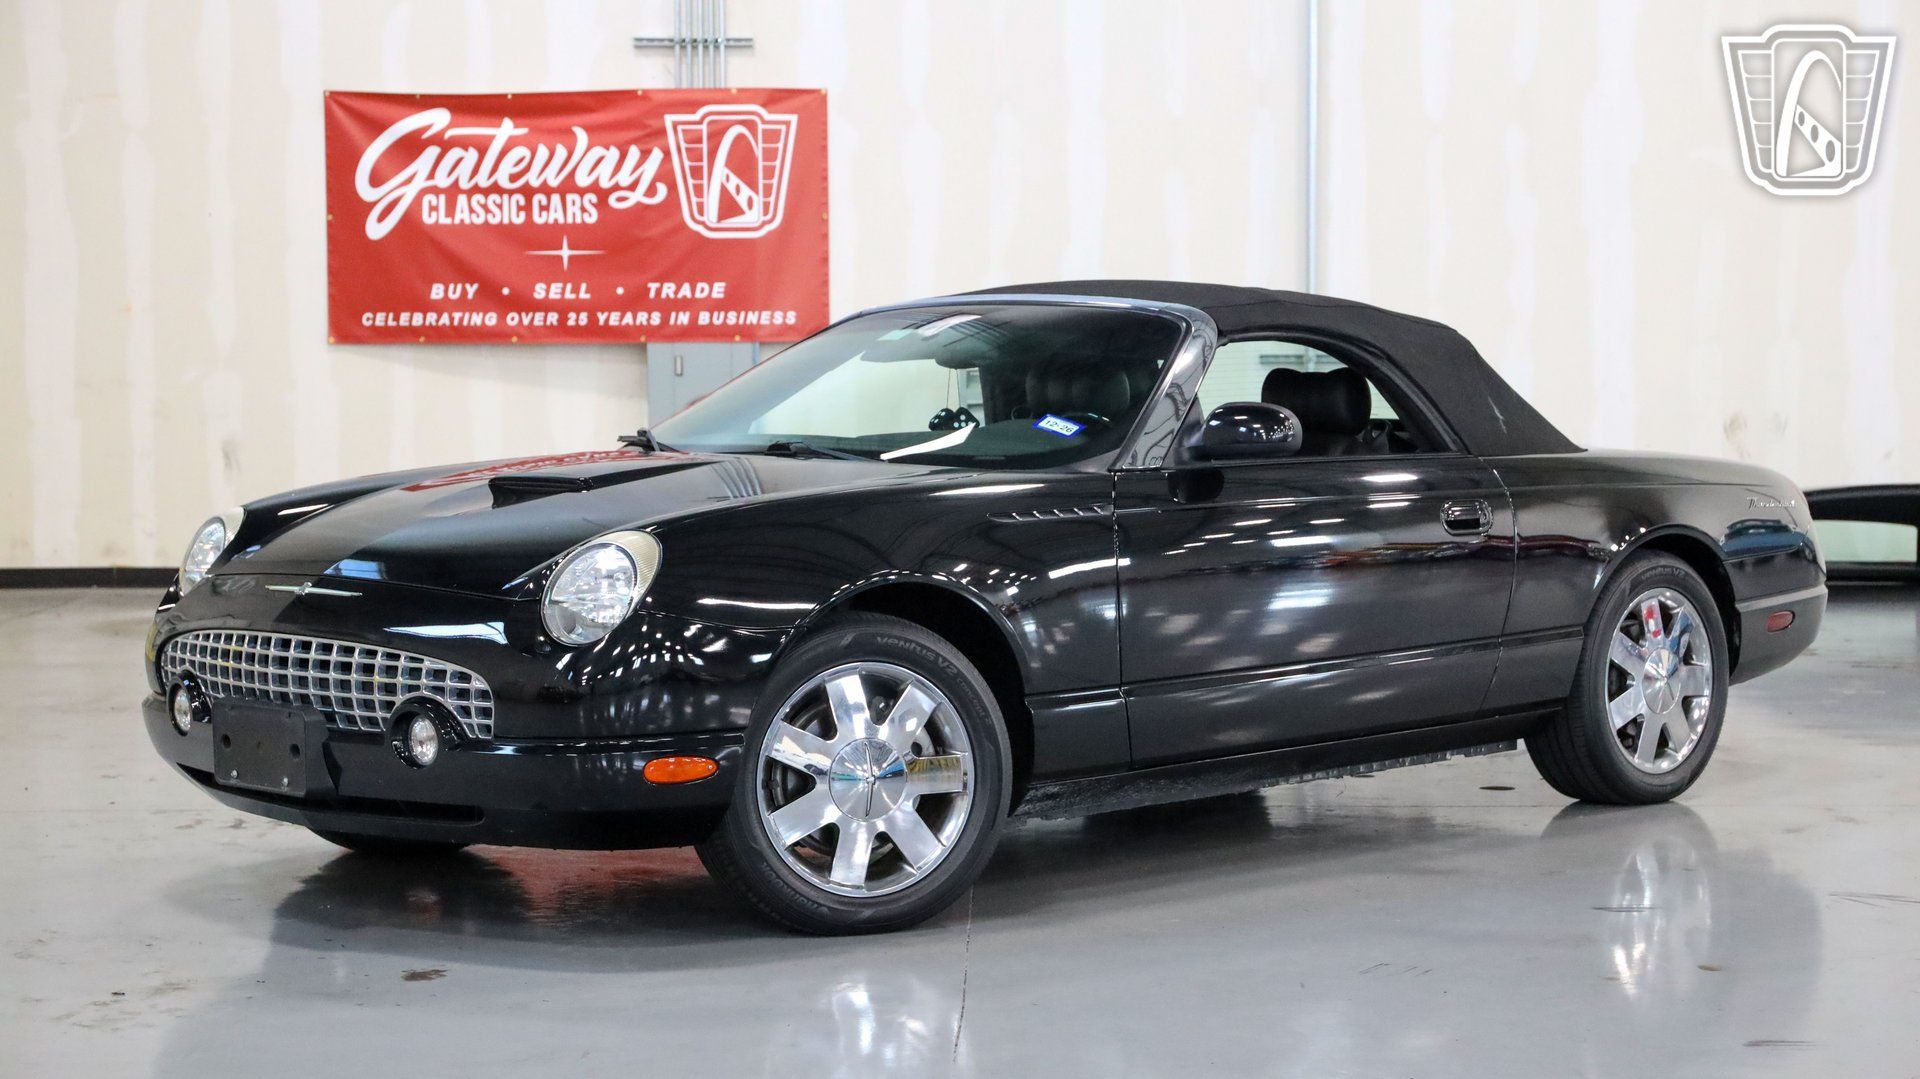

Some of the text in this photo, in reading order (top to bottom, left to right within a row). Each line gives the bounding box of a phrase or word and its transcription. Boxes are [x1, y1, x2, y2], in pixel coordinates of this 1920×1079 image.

[355, 108, 668, 240] Gateway
[421, 192, 599, 225] CLASSIC CARS
[430, 281, 727, 300] BUY SELL TRADE
[361, 310, 798, 327] CELEBRATING OVER 25 YEARS IN BUSINESS
[938, 656, 958, 677] V2
